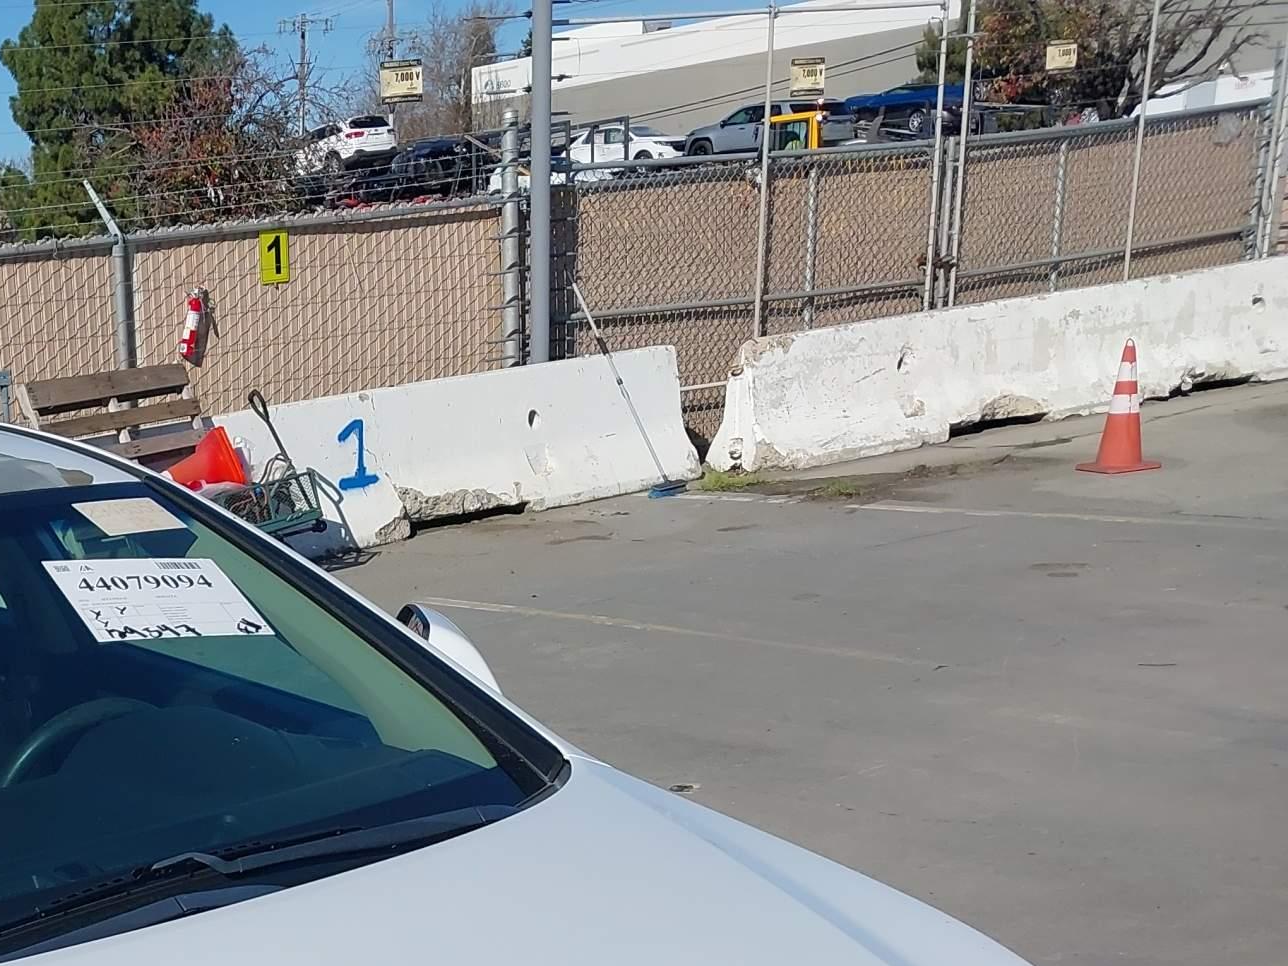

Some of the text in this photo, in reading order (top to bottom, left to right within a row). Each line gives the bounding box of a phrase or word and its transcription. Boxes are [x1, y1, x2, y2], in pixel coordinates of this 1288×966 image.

[394, 72, 420, 83] 7,000 V
[266, 235, 282, 275] 1
[337, 419, 379, 491] 1
[78, 573, 213, 593] 44079094
